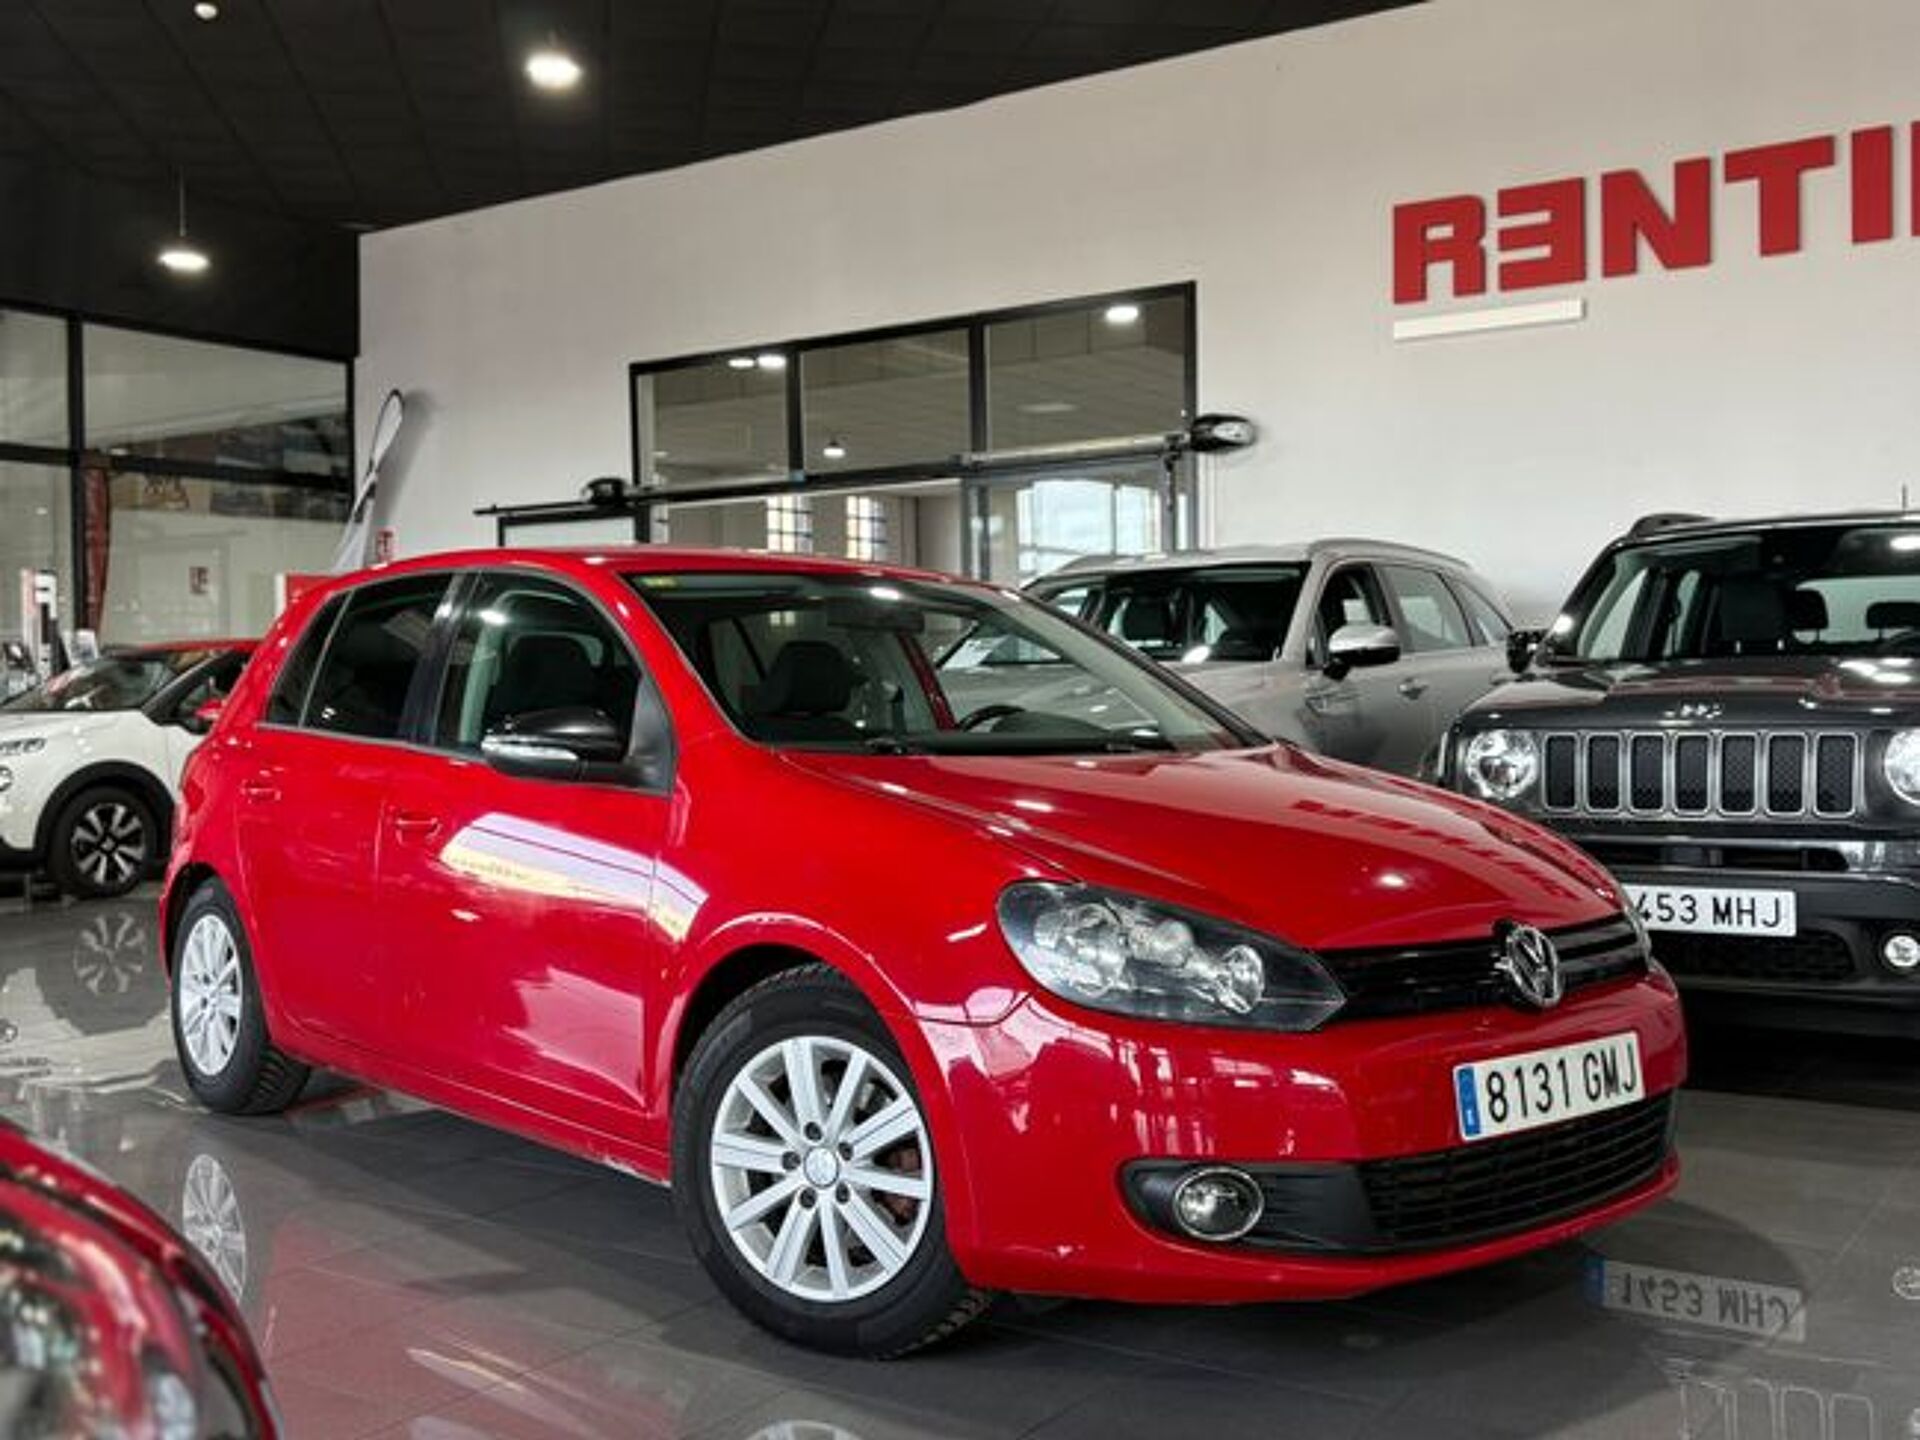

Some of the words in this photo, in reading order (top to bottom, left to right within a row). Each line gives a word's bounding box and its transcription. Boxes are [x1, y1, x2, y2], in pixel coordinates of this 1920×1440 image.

[1393, 121, 1920, 304] RENTI
[1634, 893, 1699, 925] 453
[1712, 896, 1780, 928] MHJ
[1485, 1057, 1571, 1124] 8131
[1582, 1042, 1637, 1102] GMJ
